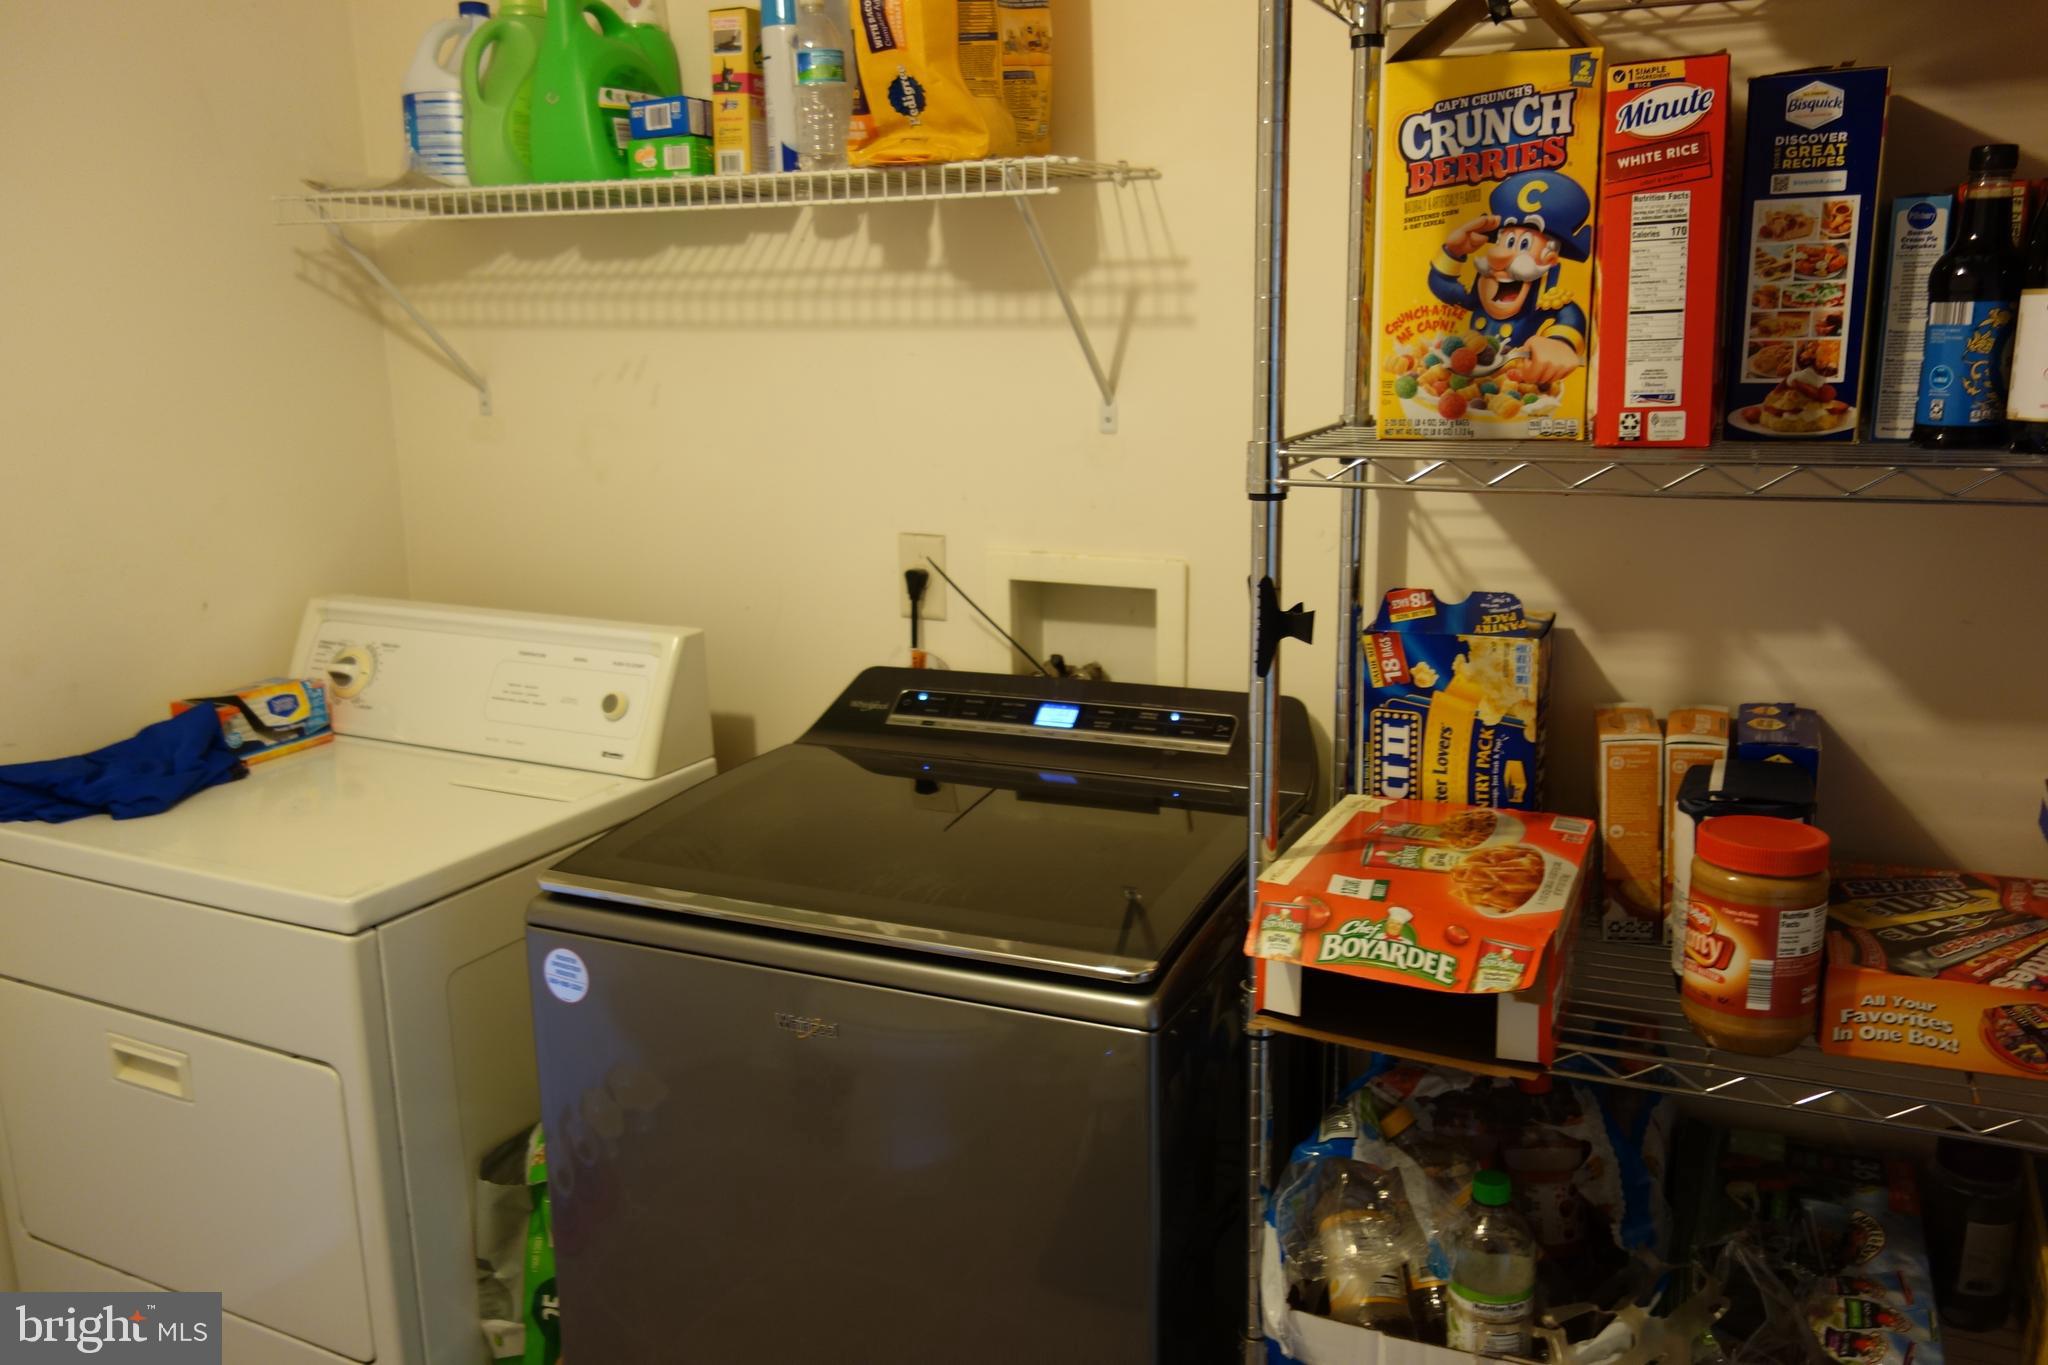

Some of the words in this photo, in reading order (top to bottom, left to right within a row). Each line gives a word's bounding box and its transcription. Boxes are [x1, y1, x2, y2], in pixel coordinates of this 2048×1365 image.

[864, 0, 876, 23] BACO
[869, 24, 883, 49] WITH
[1577, 60, 1592, 76] 2
[1635, 65, 1667, 76] SIMPLE
[897, 64, 921, 127] Pedigree
[1435, 97, 1470, 113] CAP'N
[1471, 84, 1533, 105] CRUNCH'S
[1788, 96, 1842, 113] Bisquick
[1618, 88, 1714, 132] Minute
[1401, 90, 1577, 160] CRUNCH
[1774, 131, 1848, 146] DISCOVER
[1785, 143, 1848, 158] GREAT
[1408, 136, 1566, 195] BERRIES
[1617, 150, 1662, 169] WHITE
[1666, 143, 1700, 159] RICE
[1782, 156, 1846, 170] RECIPES
[1669, 191, 1689, 201] Facts
[1671, 226, 1688, 237] 170
[1396, 328, 1414, 344] ME
[1411, 591, 1431, 608] 18
[1474, 619, 1528, 634] PANTRY
[1481, 612, 1518, 623] PACK
[1378, 636, 1393, 660] BAGS
[1382, 657, 1403, 684] 18
[1432, 727, 1453, 775] Lovers
[1475, 728, 1496, 769] PACK
[1381, 761, 1410, 799] CT
[1473, 772, 1491, 808] NTRY
[1339, 919, 1383, 940] Chef
[1319, 934, 1457, 985] BOYARDEE
[1861, 995, 1886, 1007] All
[1893, 995, 1937, 1012] Your
[1840, 1008, 1953, 1034] Favorites
[1833, 1026, 1853, 1042] In
[1859, 1026, 1903, 1042] One
[1907, 1029, 1960, 1054] Box!
